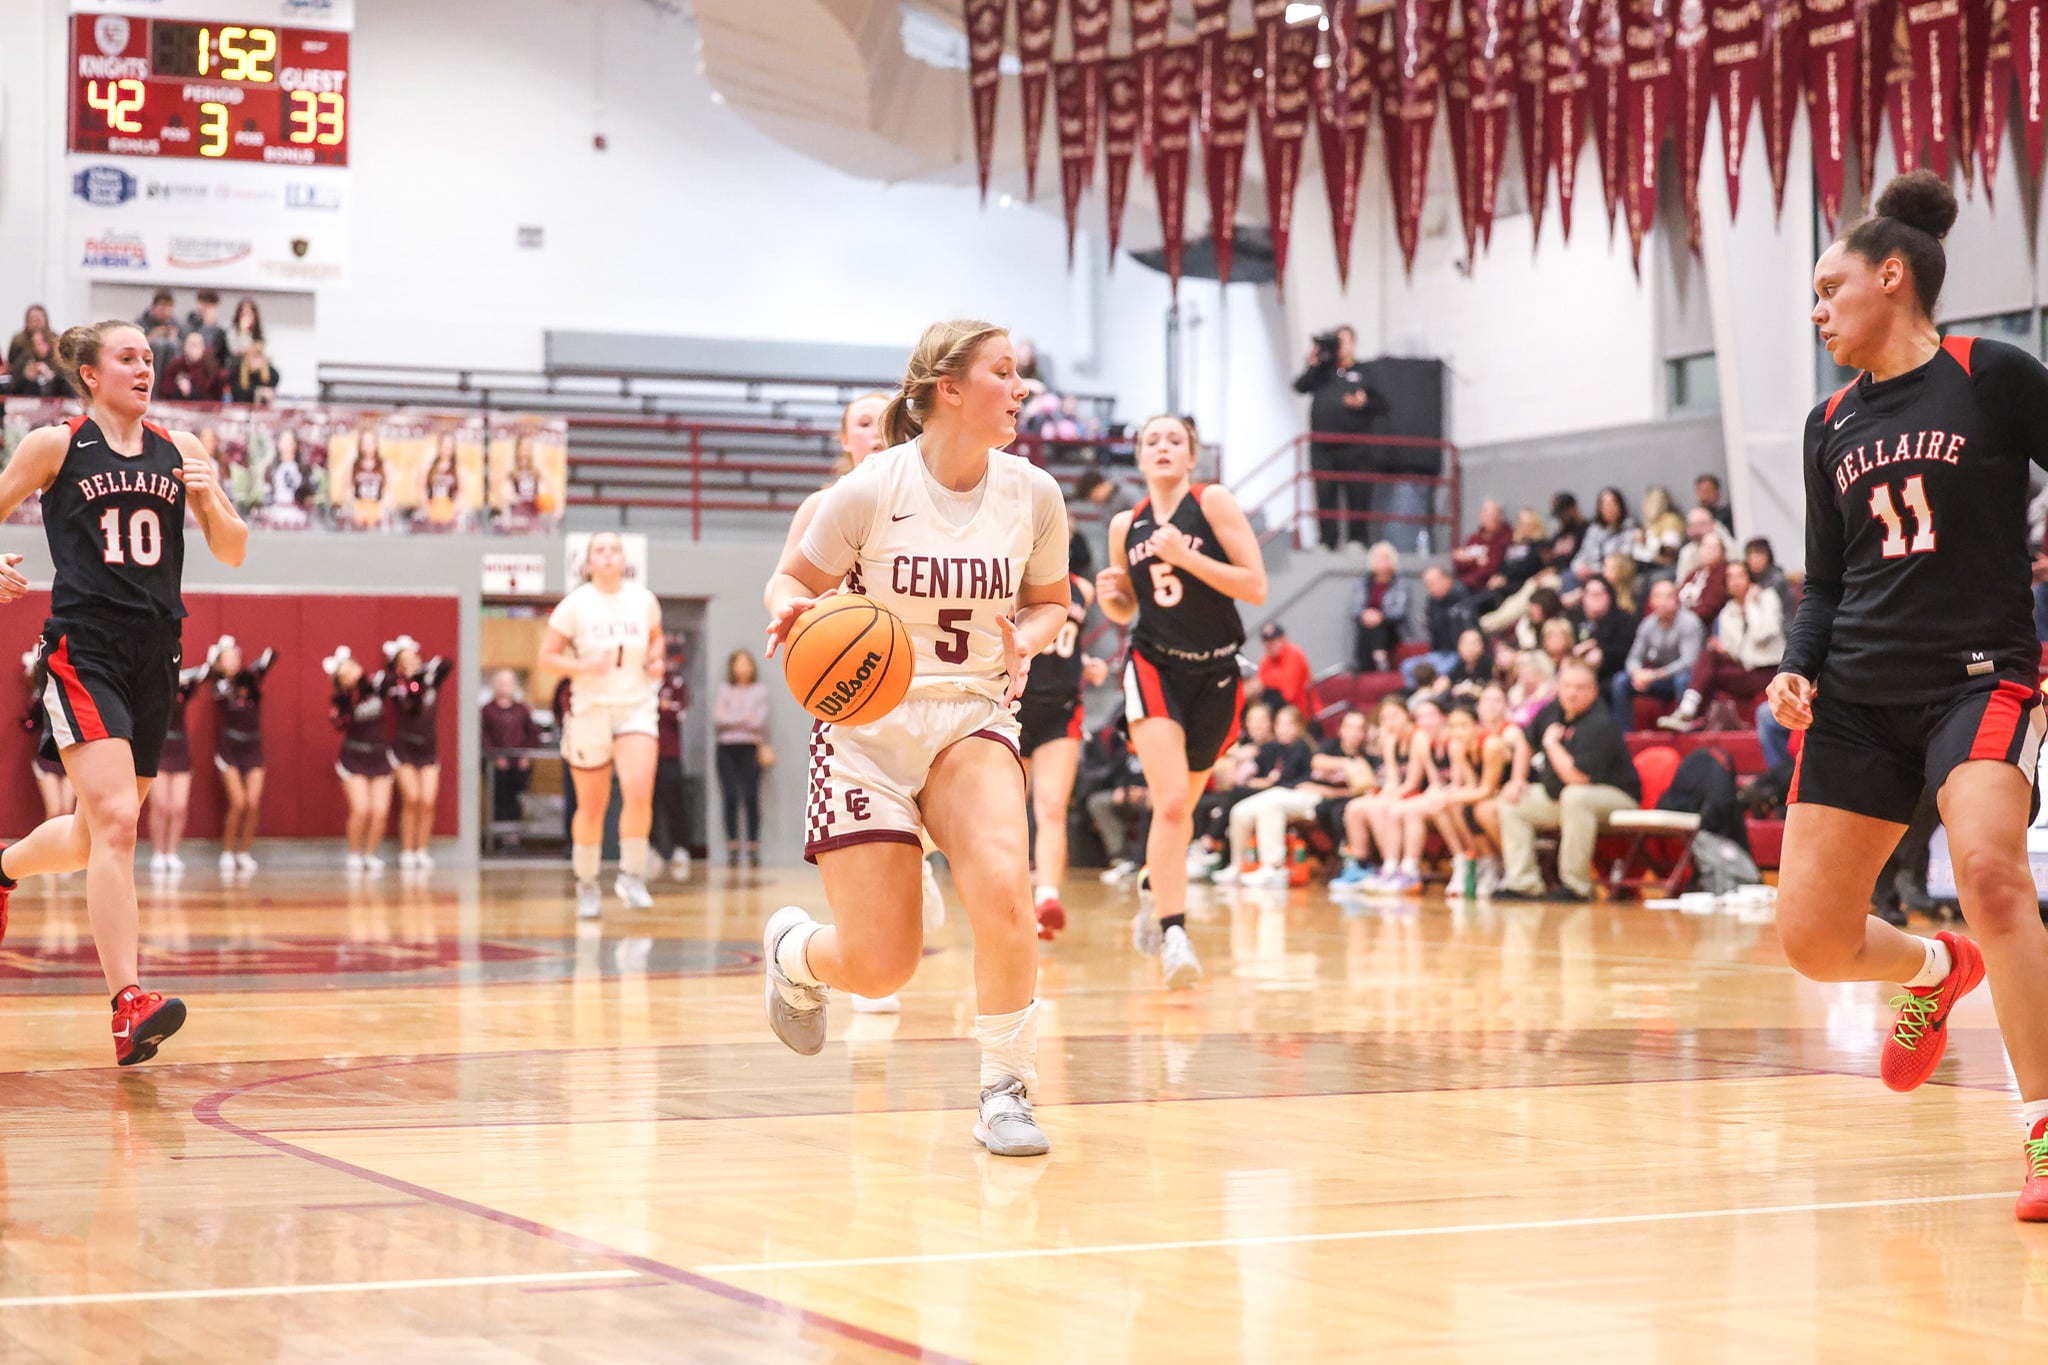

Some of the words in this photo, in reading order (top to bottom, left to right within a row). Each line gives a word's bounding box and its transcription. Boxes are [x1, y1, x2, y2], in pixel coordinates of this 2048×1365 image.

[78, 54, 148, 80] KNIGHTS
[279, 67, 347, 93] GUEST
[87, 79, 145, 133] 42
[182, 84, 245, 105] PERIOD
[289, 89, 344, 145] 33
[108, 137, 160, 153] BONUS
[199, 102, 229, 157] 3
[263, 147, 315, 164] BONUS
[1836, 430, 1966, 495] BELLAIRE
[78, 470, 179, 505] BELLAIRE
[100, 507, 163, 567] 10
[1868, 473, 1936, 559] 11
[891, 555, 1013, 600] CENTRAL
[1149, 562, 1183, 608] 5
[616, 644, 624, 668] 1
[934, 608, 973, 665] 5
[1972, 651, 1984, 661] M
[815, 651, 882, 716] Wilson
